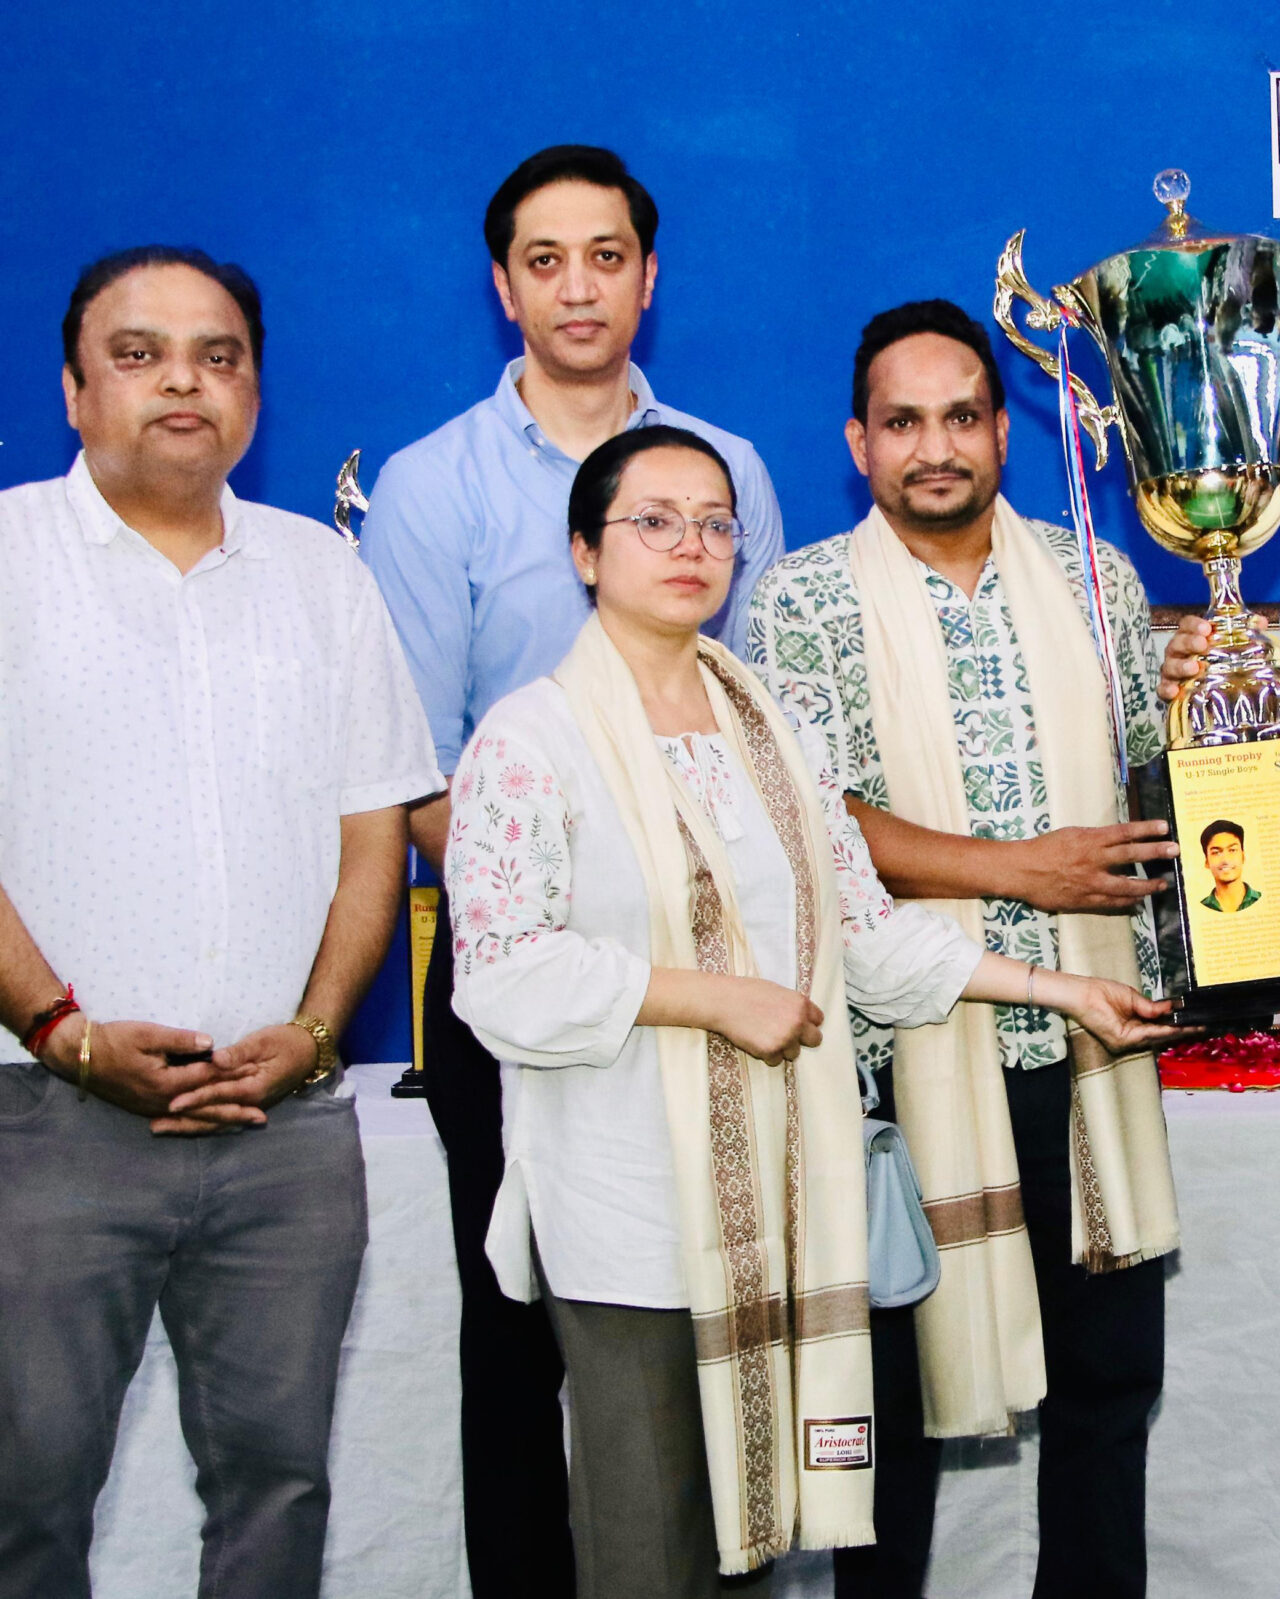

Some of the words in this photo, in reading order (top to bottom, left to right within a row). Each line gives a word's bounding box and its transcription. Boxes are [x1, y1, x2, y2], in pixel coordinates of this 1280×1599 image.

[1177, 756, 1222, 768] Running
[1224, 751, 1262, 763] Trophy
[1207, 767, 1235, 777] Single
[1237, 764, 1259, 774] Boys
